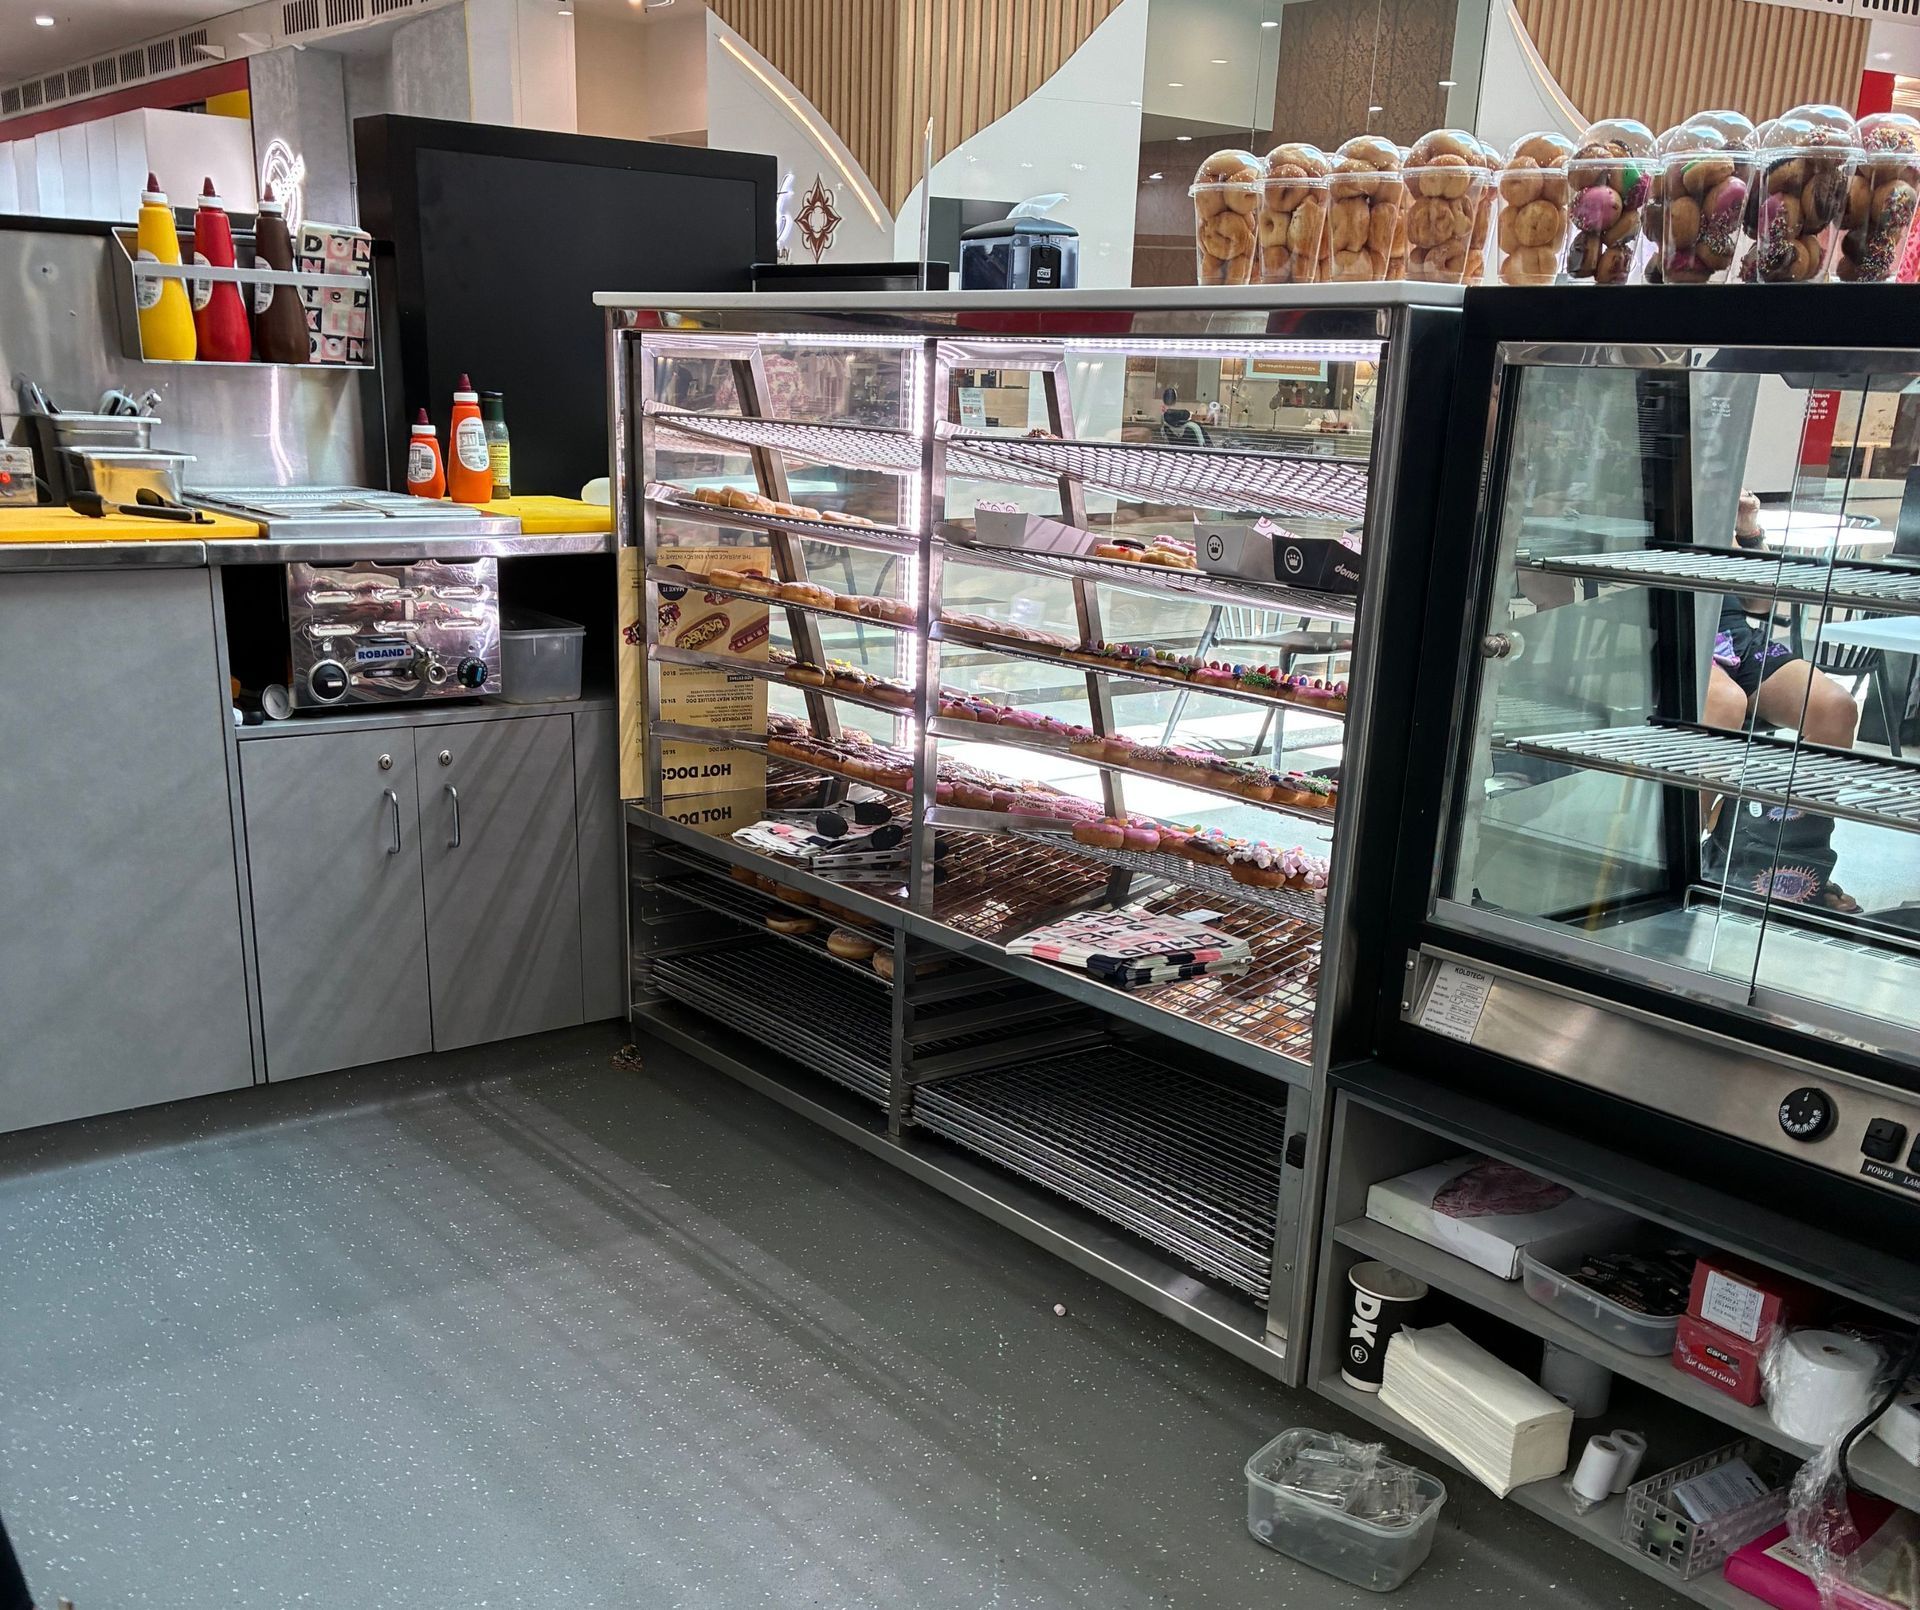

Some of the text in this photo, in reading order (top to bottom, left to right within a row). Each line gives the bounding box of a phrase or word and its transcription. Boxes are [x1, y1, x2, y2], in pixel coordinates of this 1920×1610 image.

[358, 649, 405, 660] ROBAND
[701, 764, 731, 778] HOT
[1454, 967, 1486, 981] KOLDTECH
[1866, 1164, 1895, 1179] POWER
[1349, 1290, 1382, 1348] DK
